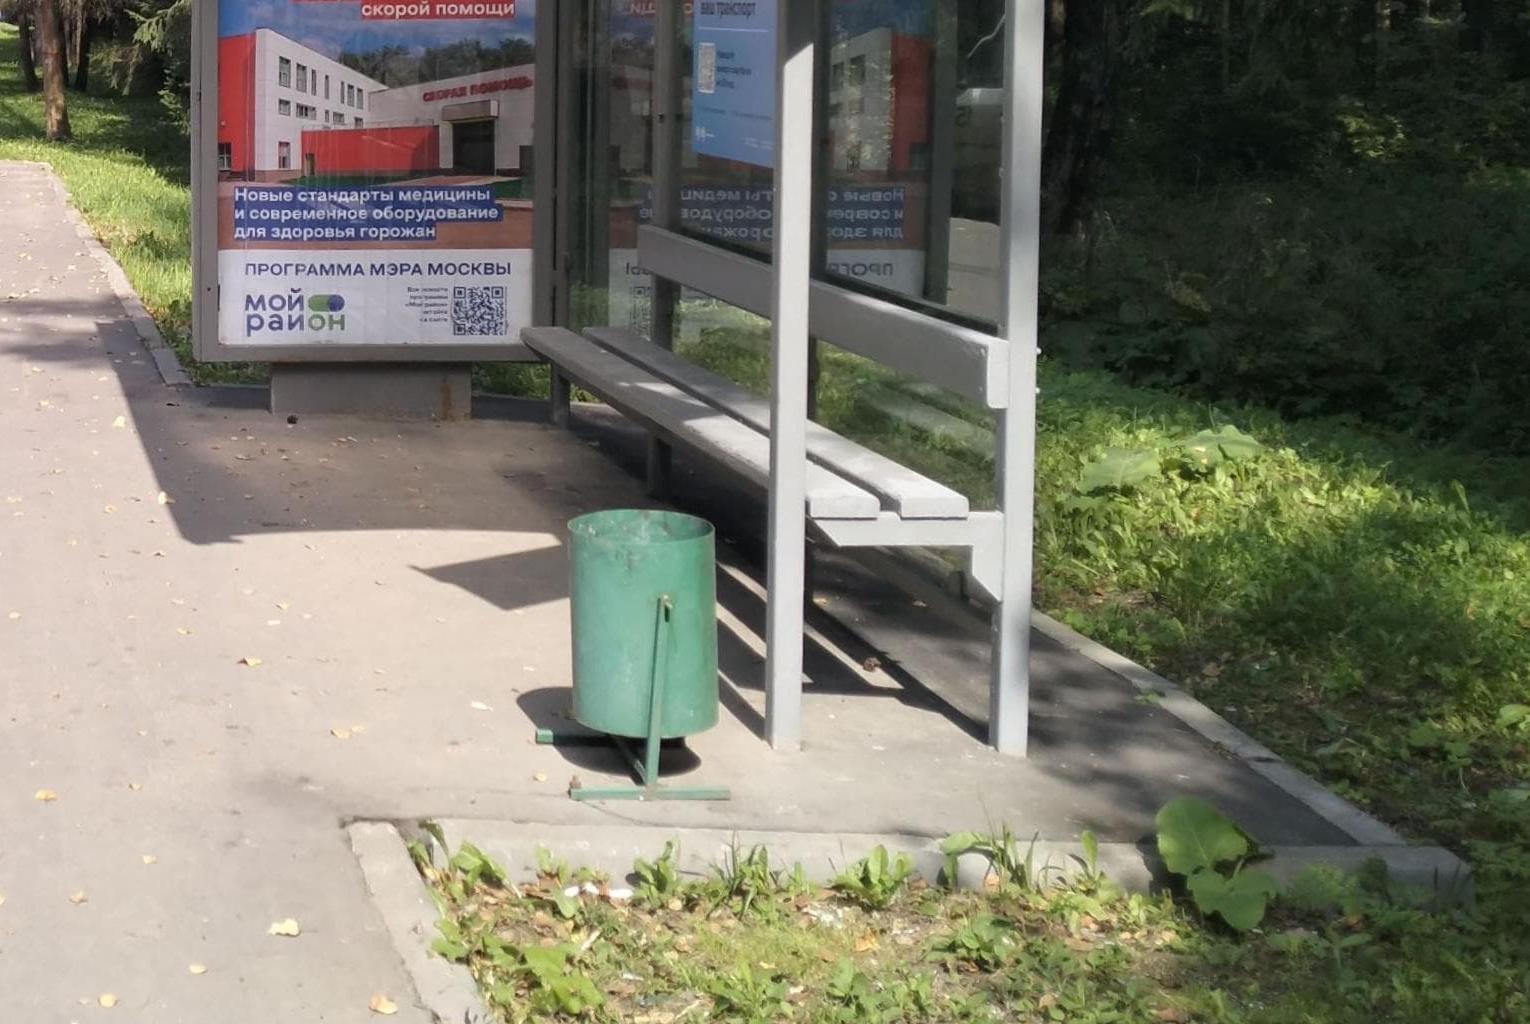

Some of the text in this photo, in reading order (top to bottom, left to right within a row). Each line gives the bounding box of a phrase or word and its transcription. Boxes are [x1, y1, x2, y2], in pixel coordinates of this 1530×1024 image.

[361, 1, 515, 19] скорой помощи
[234, 187, 490, 205] Новые стандарты медицины
[234, 205, 498, 223] и современное оборудование
[234, 225, 436, 241] для здоровья горожан
[245, 262, 511, 276] ПРОГРАММА МЭРА МОСКВЫ
[245, 287, 305, 311] мой
